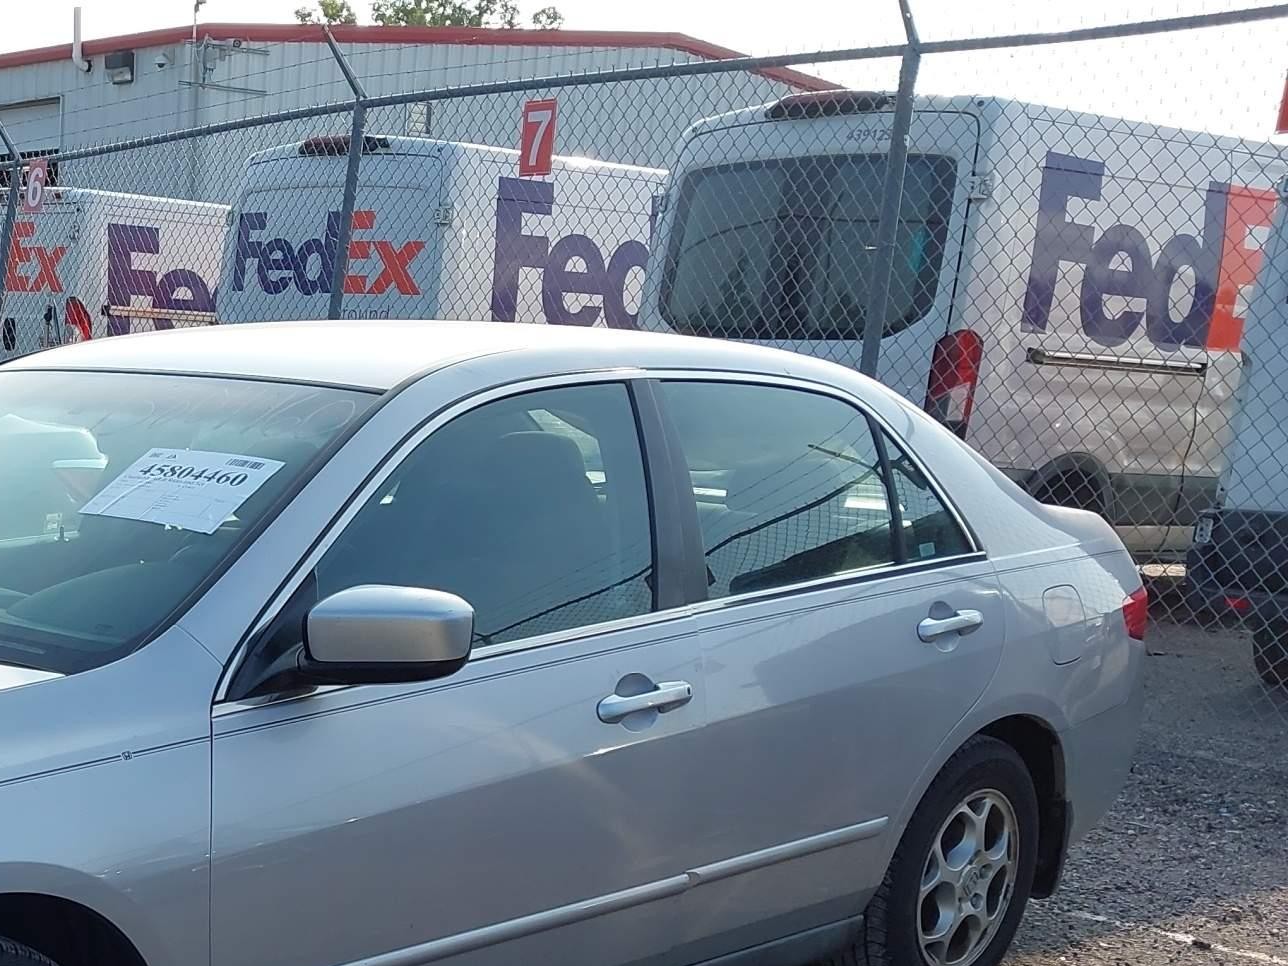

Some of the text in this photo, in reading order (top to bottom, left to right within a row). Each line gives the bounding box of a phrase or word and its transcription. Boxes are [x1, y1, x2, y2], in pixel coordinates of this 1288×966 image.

[527, 109, 553, 167] 7
[27, 167, 44, 208] 6
[232, 210, 427, 296] FedEx
[139, 463, 249, 488] 45804460
